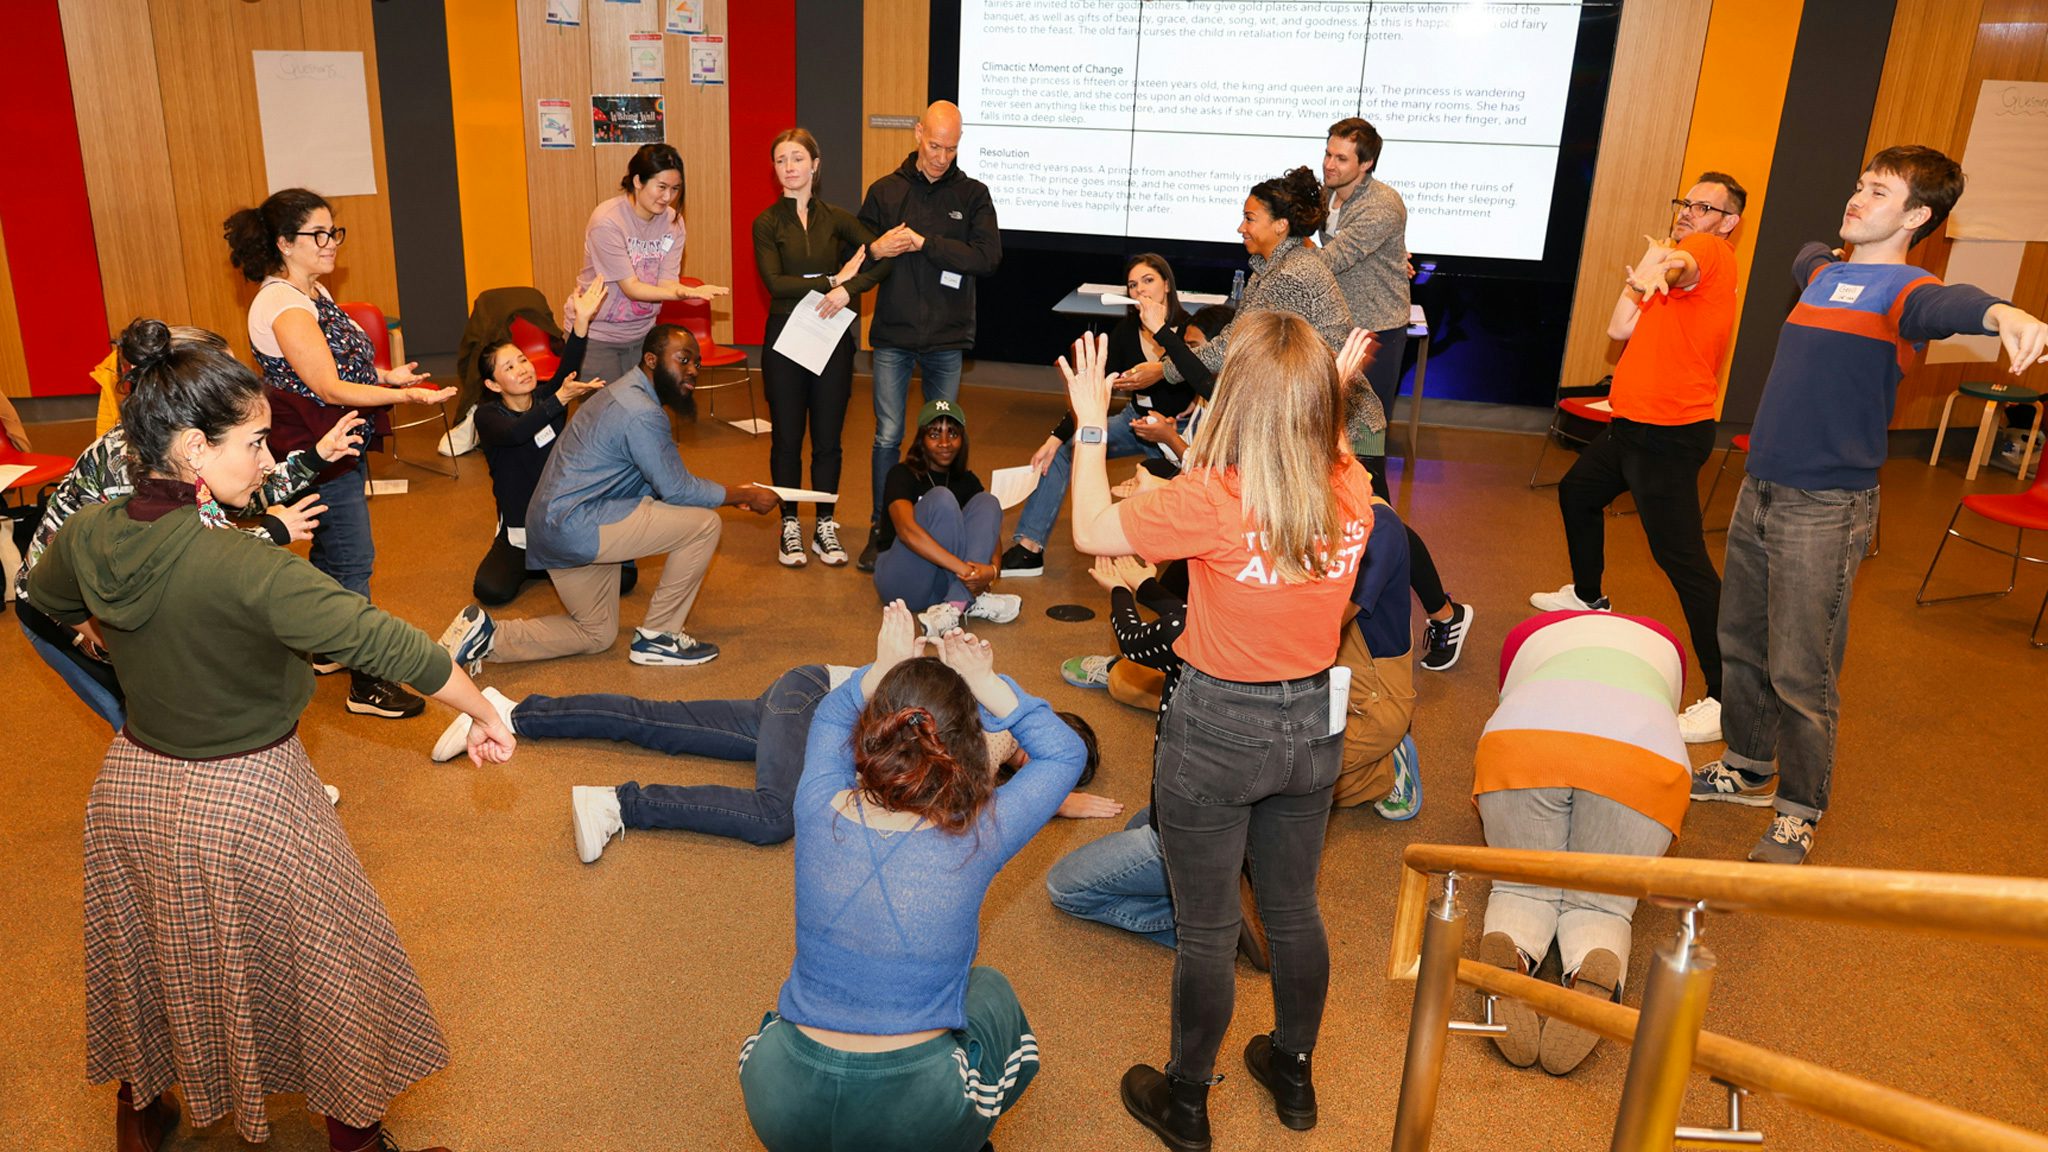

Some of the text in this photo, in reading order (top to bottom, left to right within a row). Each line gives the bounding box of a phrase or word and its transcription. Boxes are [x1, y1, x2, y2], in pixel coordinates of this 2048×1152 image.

[1070, 0, 1080, 9] to
[1083, 0, 1095, 9] be
[1098, 0, 1113, 10] her
[1187, 1, 1210, 14] They
[1214, 2, 1235, 14] give
[1239, 2, 1262, 14] gold
[1265, 3, 1298, 15] plates
[1300, 3, 1321, 12] and
[1324, 6, 1350, 15] cups
[1379, 4, 1414, 16] jewels
[1417, 5, 1447, 14] when
[1521, 6, 1540, 15] the
[1042, 13, 1061, 22] well
[1077, 13, 1100, 25] gifts
[1103, 14, 1113, 23] of
[1281, 17, 1302, 26] and
[1305, 17, 1360, 29] goodness.
[1381, 18, 1402, 27] this
[1500, 20, 1518, 29] old
[1522, 20, 1548, 32] fairy
[1017, 26, 1027, 34] to
[1030, 25, 1045, 34] the
[1048, 25, 1075, 35] feast.
[1079, 26, 1096, 35] The
[1099, 26, 1115, 36] old
[1144, 29, 1176, 37] curses
[1179, 28, 1196, 37] the
[1199, 28, 1223, 38] child
[1227, 29, 1236, 38] in
[1239, 29, 1292, 39] retaliation
[1296, 30, 1310, 39] for
[1314, 30, 1344, 43] being
[982, 62, 1123, 77] Climactic Moment of Change
[982, 74, 1009, 84] When
[1012, 75, 1027, 84] the
[1030, 76, 1070, 87] princess
[1073, 77, 1080, 86] is
[1083, 77, 1115, 87] fifteen
[1171, 82, 1198, 91] years
[1223, 81, 1239, 90] the
[1242, 82, 1264, 94] king
[1267, 83, 1287, 92] and
[1290, 85, 1323, 95] queen
[1382, 86, 1401, 95] The
[1404, 87, 1450, 98] princess
[1453, 88, 1462, 97] is
[1465, 88, 1525, 101] wandering
[981, 86, 1019, 99] through
[1022, 88, 1038, 97] the
[1073, 90, 1092, 99] and
[1095, 90, 1112, 100] she
[1151, 94, 1176, 104] upon
[1194, 93, 1210, 103] old
[1213, 96, 1251, 104] woman
[1254, 96, 1298, 108] spinning
[1301, 97, 1327, 106] wool
[1330, 98, 1339, 107] in
[1366, 99, 1378, 108] of
[1381, 99, 1398, 109] the
[1401, 102, 1431, 112] many
[1434, 103, 1472, 111] rooms.
[1476, 102, 1497, 111] She
[1500, 103, 1520, 112] has
[981, 101, 1008, 109] never
[1034, 101, 1077, 114] anything
[1079, 102, 1096, 112] like
[1099, 103, 1117, 112] this
[1158, 105, 1177, 114] and
[1180, 106, 1197, 115] she
[1200, 106, 1222, 116] asks
[1225, 107, 1232, 116] if
[1235, 107, 1253, 117] she
[1277, 109, 1294, 121] try.
[1298, 109, 1328, 119] When
[1385, 112, 1405, 122] she
[1408, 114, 1441, 125] pricks
[1444, 114, 1462, 124] her
[1505, 117, 1527, 126] and
[981, 111, 1000, 121] falls
[1002, 112, 1021, 122] into
[1031, 113, 1055, 126] deep
[1057, 114, 1086, 127] sleep.
[980, 148, 1030, 158] Resolution
[979, 160, 1251, 183] One hundred years pass. A from another family is
[979, 171, 1239, 195] the castle. The prince goes and he comes upon
[1419, 181, 1514, 193] upon the ruins of
[1017, 186, 1044, 195] struck
[1048, 187, 1059, 199] by
[1062, 187, 1078, 197] her
[1080, 188, 1112, 202] beauty
[1139, 191, 1151, 201] he
[1154, 192, 1174, 202] falls
[1192, 194, 1206, 204] his
[1209, 195, 1237, 205] knees
[1417, 193, 1517, 209] finds her sleeping.
[1016, 197, 1059, 210] Everyone
[1062, 200, 1083, 210] lives
[1085, 201, 1120, 214] happily
[1418, 207, 1491, 219] enchantment
